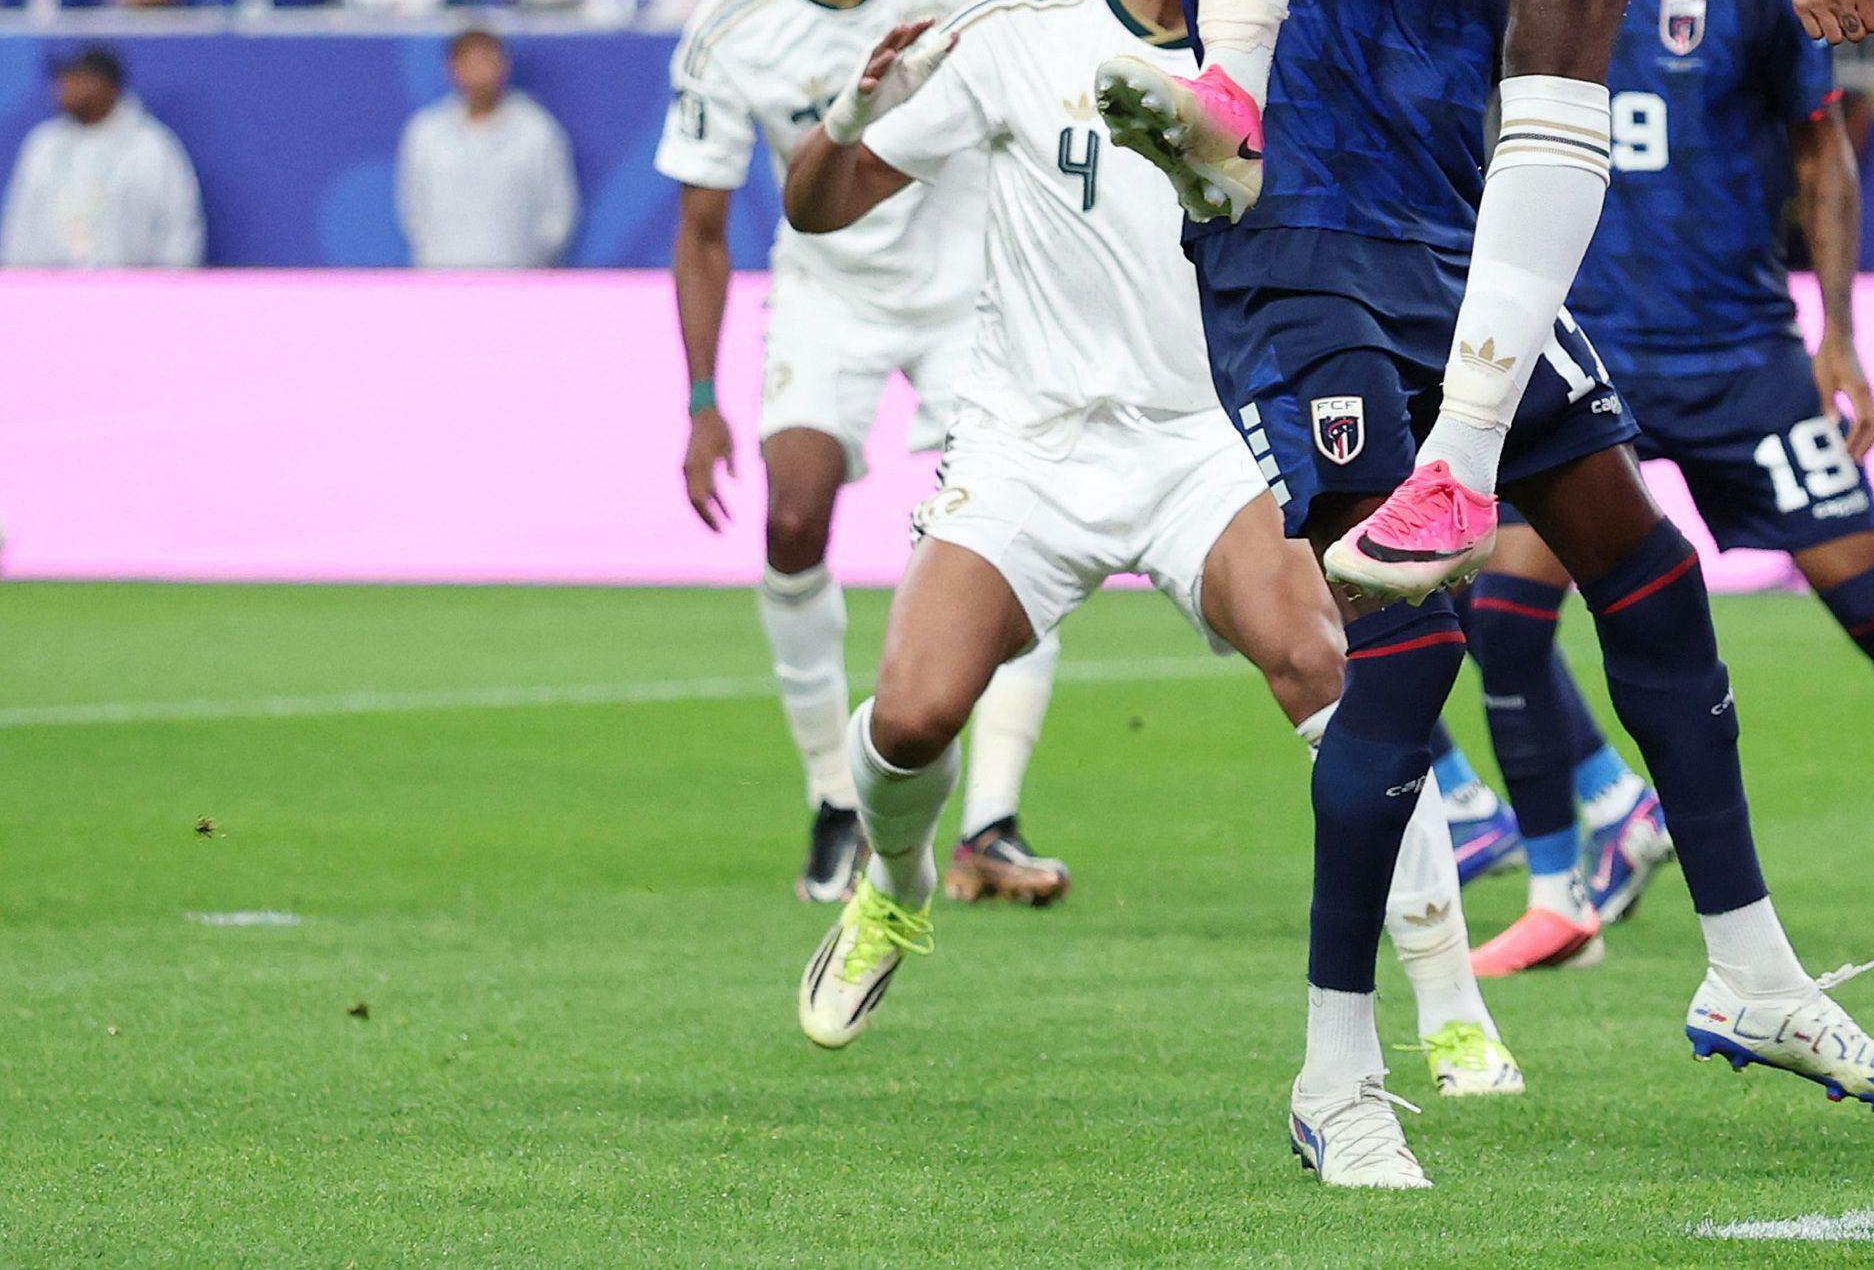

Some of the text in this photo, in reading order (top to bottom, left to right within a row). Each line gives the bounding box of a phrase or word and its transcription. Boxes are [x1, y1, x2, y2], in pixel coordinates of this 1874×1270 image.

[1058, 126, 1099, 213] 4
[1611, 90, 1670, 172] 9
[1317, 400, 1358, 411] FCF
[1753, 415, 1861, 514] 19
